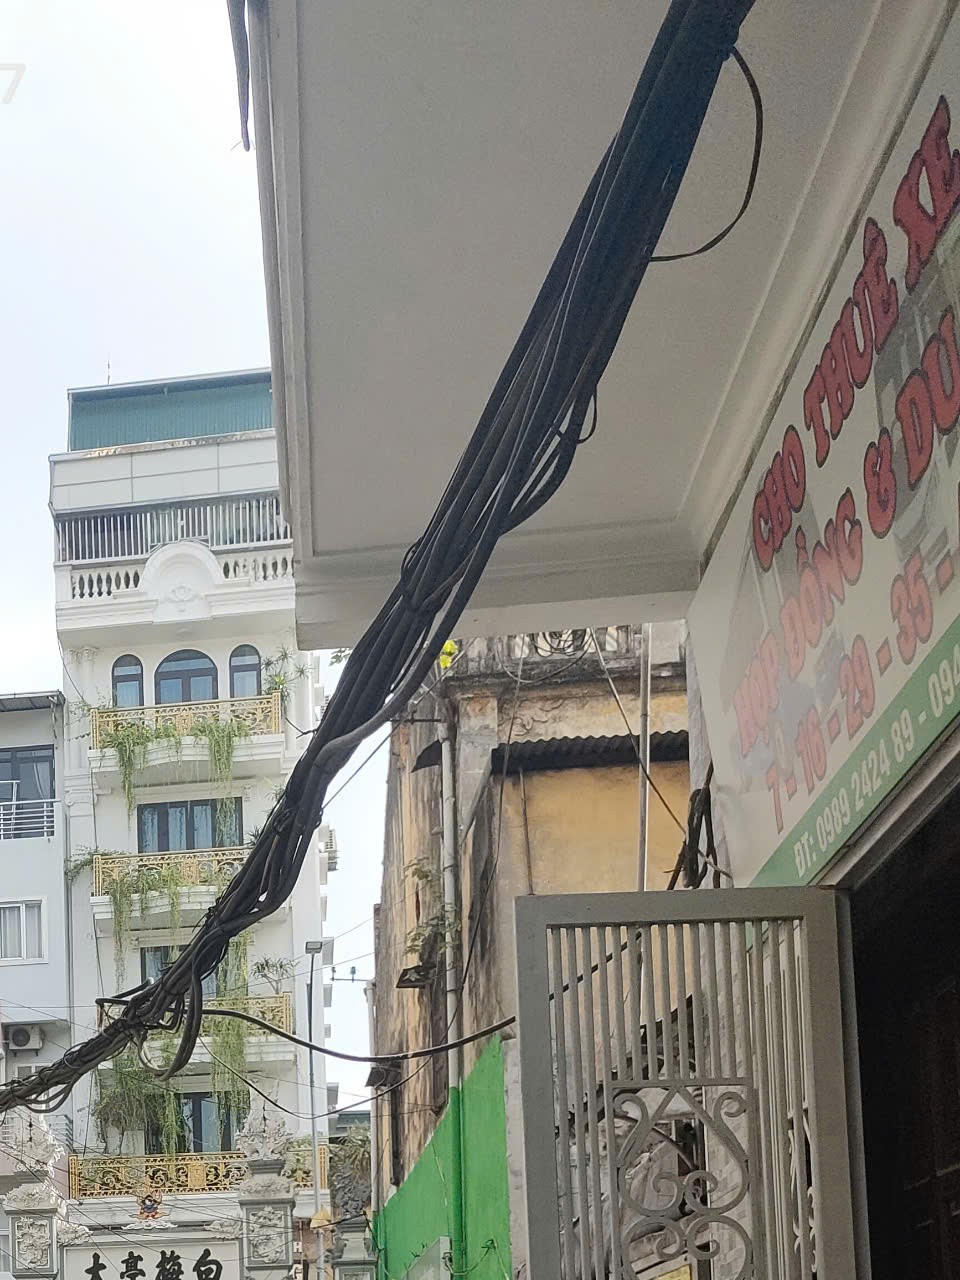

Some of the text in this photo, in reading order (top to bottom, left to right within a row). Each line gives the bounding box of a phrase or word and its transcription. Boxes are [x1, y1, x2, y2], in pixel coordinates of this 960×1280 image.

[753, 424, 806, 572] CHO
[803, 218, 899, 467] THUÊ
[864, 427, 897, 539] &
[796, 703, 827, 796] 16
[840, 634, 876, 741] 29
[891, 549, 934, 665] 35
[816, 789, 851, 853] 0989
[851, 739, 890, 820] 2424
[889, 708, 915, 763] 89
